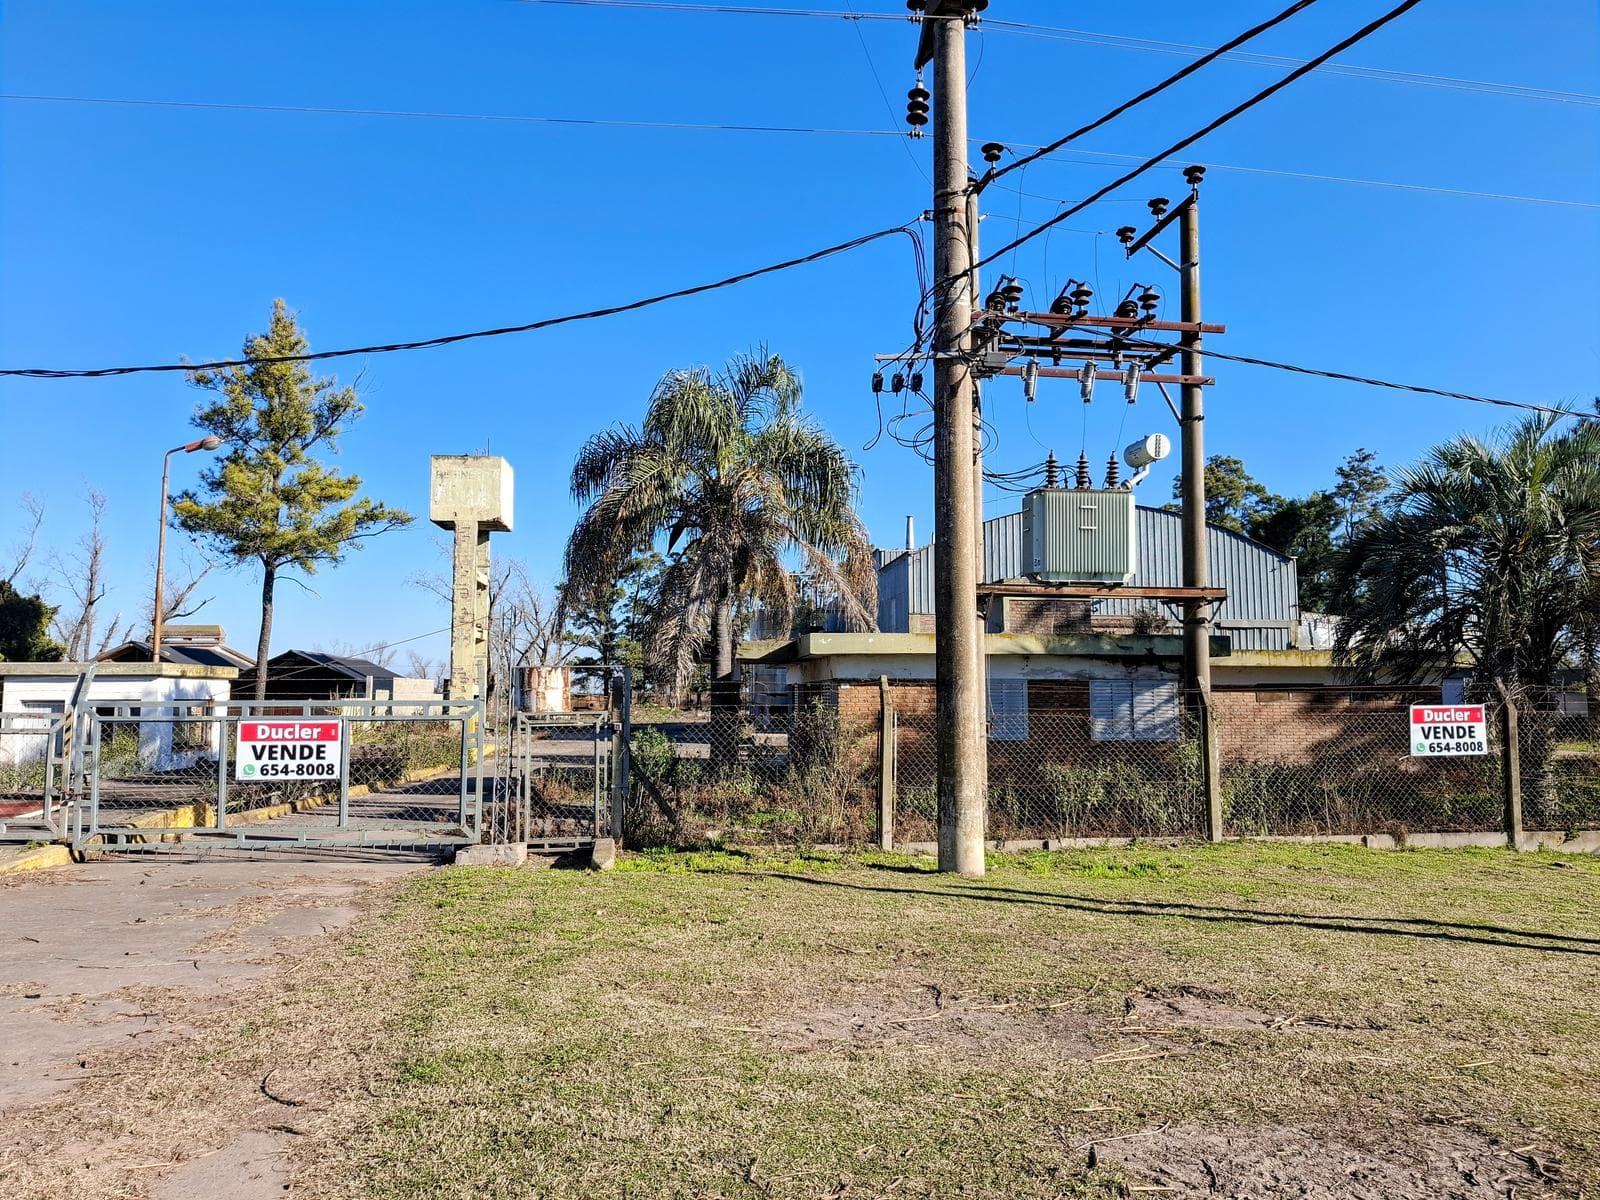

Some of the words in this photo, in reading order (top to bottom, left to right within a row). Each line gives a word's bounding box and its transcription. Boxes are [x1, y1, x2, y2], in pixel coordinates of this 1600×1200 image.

[1423, 709, 1470, 722] Ducler
[257, 724, 321, 739] Ducler
[1420, 725, 1476, 740] VENDE
[251, 744, 326, 760] VENDE
[1429, 741, 1483, 752] 654-8008
[260, 764, 335, 776] 654-8008
